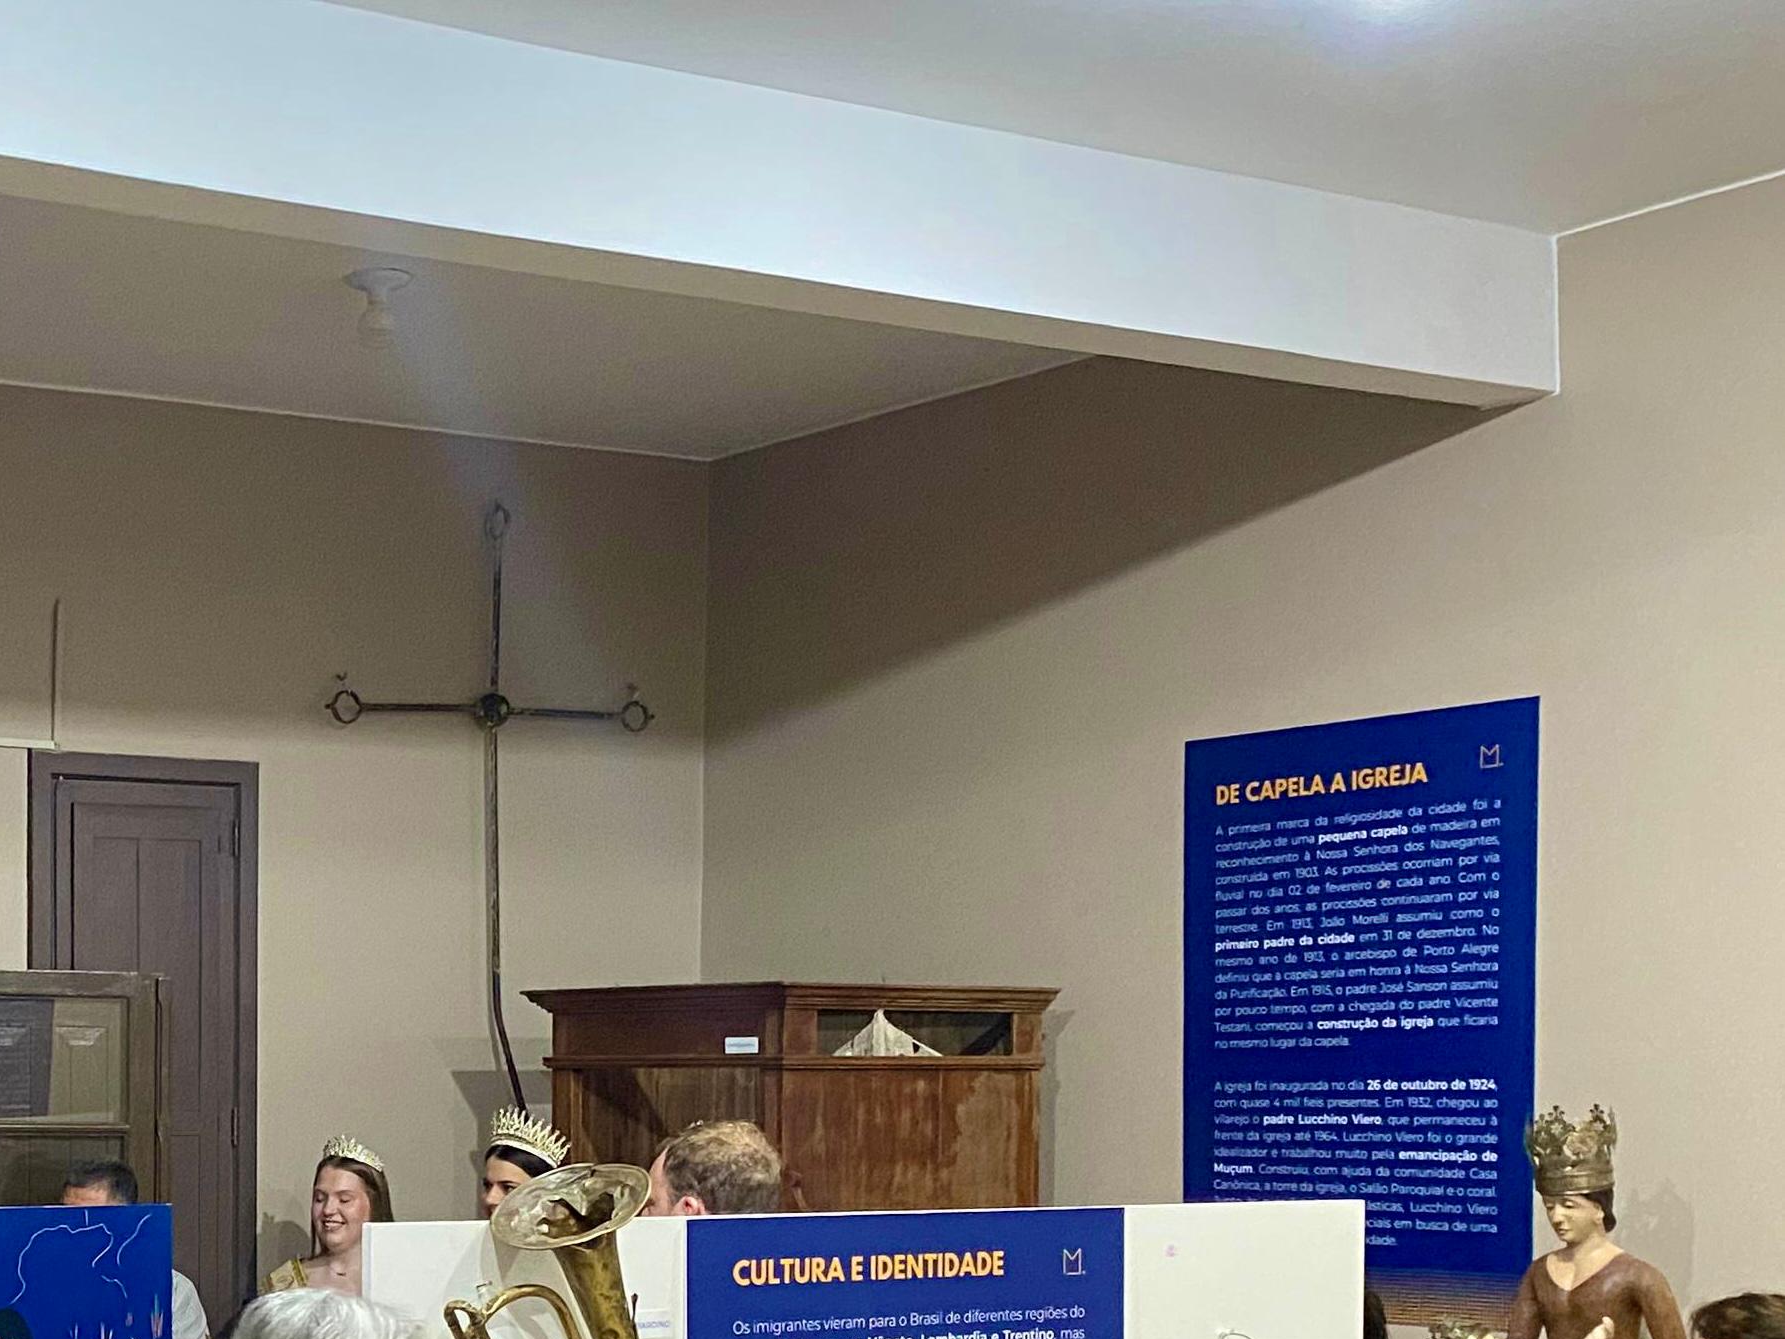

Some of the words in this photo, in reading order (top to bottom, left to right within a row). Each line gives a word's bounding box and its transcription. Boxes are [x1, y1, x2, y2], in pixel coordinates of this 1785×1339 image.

[1216, 783, 1239, 805] DE
[1245, 774, 1325, 801] CAPELA
[1329, 772, 1346, 793] A
[1351, 762, 1427, 790] IGREJA
[1215, 825, 1223, 835] A
[1228, 822, 1271, 836] primeira
[1276, 818, 1309, 829] marca
[1314, 815, 1328, 826] da
[1334, 808, 1402, 825] religiosidade
[1407, 806, 1422, 817] da
[1428, 801, 1466, 814] cidade
[1472, 798, 1487, 810] foi
[1493, 799, 1501, 808] a
[1215, 839, 1271, 851] construção
[1274, 837, 1287, 846] de
[1291, 835, 1315, 845] uma
[1318, 830, 1367, 845] pequena
[1370, 824, 1408, 838] capela
[1411, 824, 1426, 833] de
[1430, 819, 1477, 830] madeira
[1480, 817, 1500, 827] em
[1215, 938, 1259, 952] primeiro
[1263, 936, 1294, 949] padre
[1298, 935, 1313, 945] da
[1317, 932, 1355, 944] cidade
[1359, 933, 1377, 941] em
[1382, 929, 1392, 940] 31
[1397, 931, 1411, 939] de
[1482, 924, 1499, 934] No
[1316, 1017, 1378, 1030] construção
[1381, 1016, 1397, 1027] da
[1400, 1015, 1434, 1029] igreja
[1263, 1113, 1294, 1126] padre
[1298, 1113, 1348, 1124] Lucchino
[732, 1256, 845, 1286] CULTURA
[851, 1255, 863, 1281] E
[870, 1250, 1004, 1280] IDENTIDADE
[732, 1320, 750, 1334] Os
[753, 1319, 821, 1335] imigrantes
[823, 1316, 865, 1330] vieram
[868, 1316, 896, 1329] para
[898, 1316, 907, 1326] o
[909, 1311, 942, 1326] Brasil
[945, 1311, 960, 1324] de
[963, 1309, 1022, 1323] diferentes
[1025, 1306, 1067, 1322] regiões
[1069, 1304, 1085, 1318] do
[1060, 1328, 1084, 1339] mas
